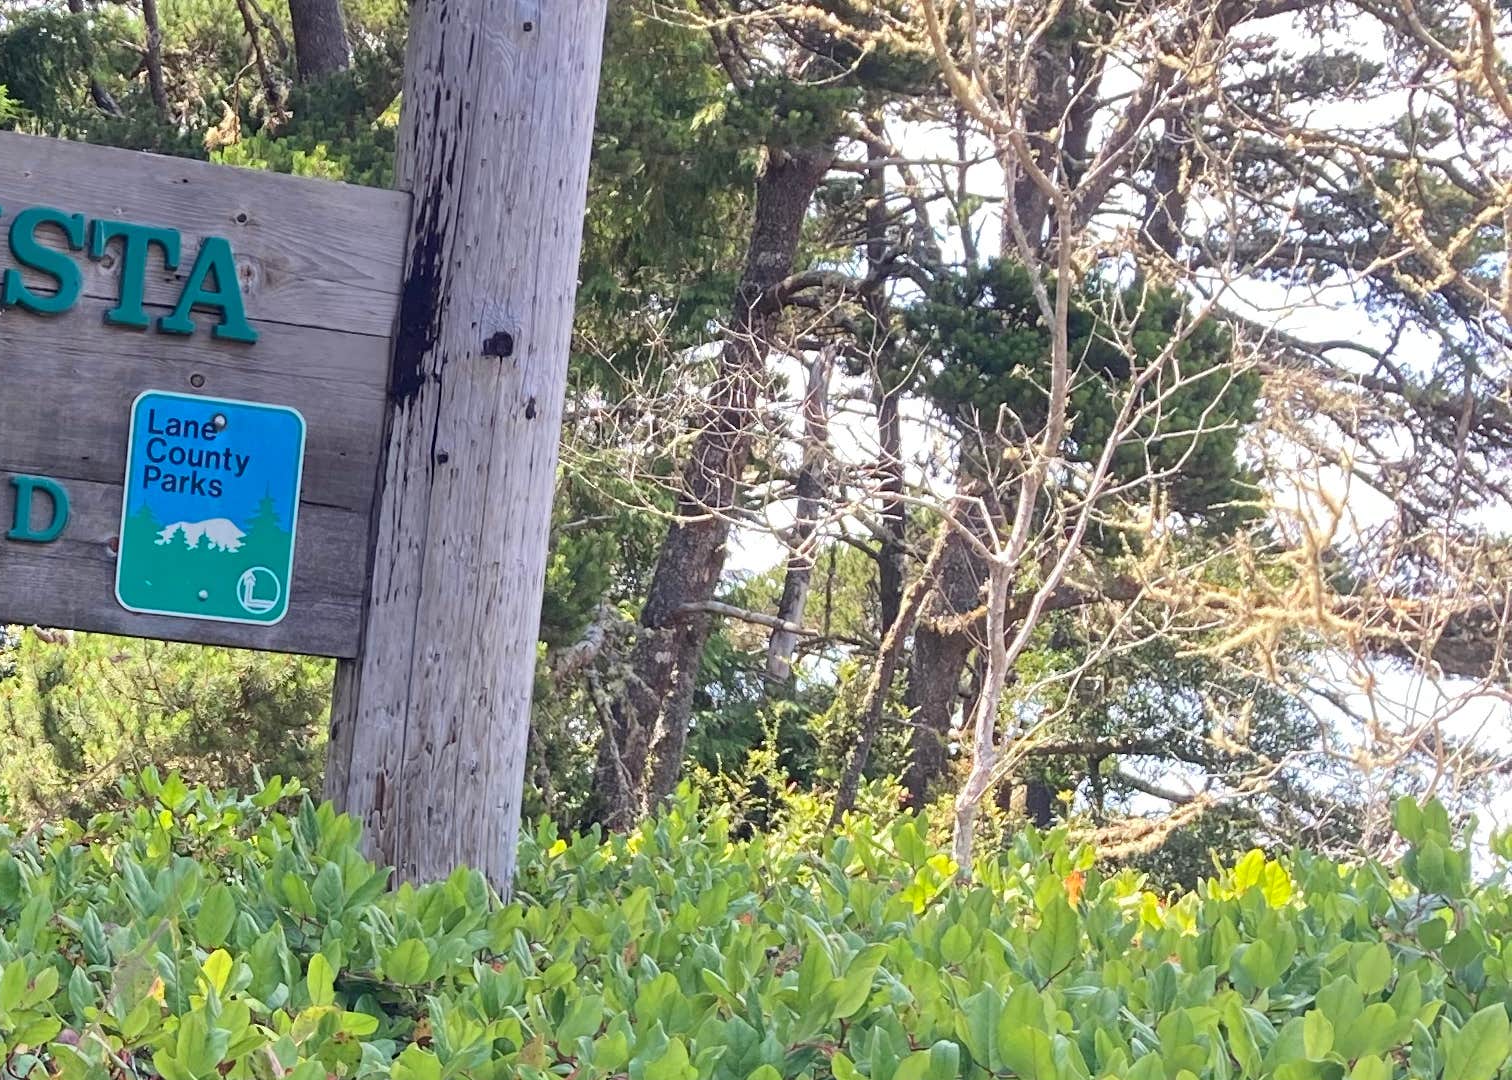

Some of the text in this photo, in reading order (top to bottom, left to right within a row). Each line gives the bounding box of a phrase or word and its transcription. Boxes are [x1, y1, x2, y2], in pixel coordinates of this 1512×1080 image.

[148, 409, 219, 441] Lane
[146, 437, 250, 477] County
[143, 465, 223, 497] Parks
